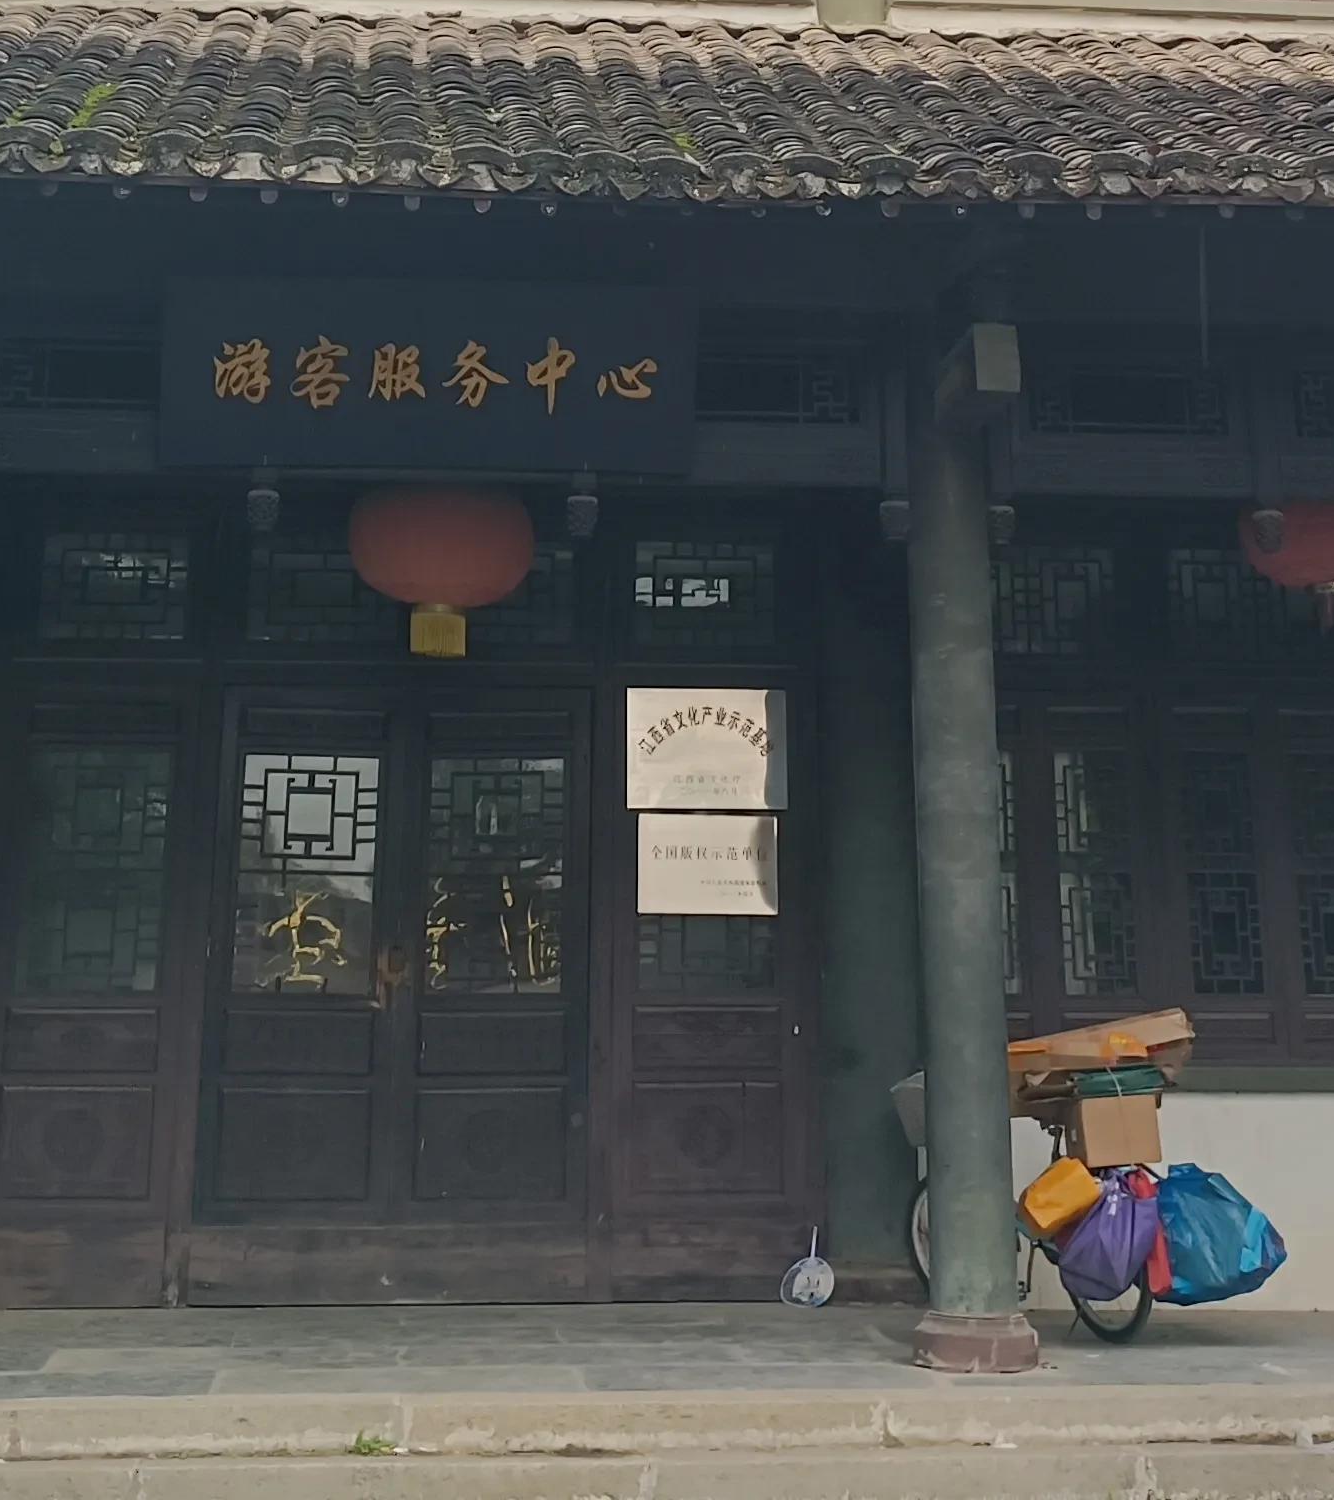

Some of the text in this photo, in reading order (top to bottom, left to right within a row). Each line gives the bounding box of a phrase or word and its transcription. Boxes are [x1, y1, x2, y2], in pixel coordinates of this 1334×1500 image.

[213, 334, 659, 416] 游客服务中心
[637, 705, 775, 757] 江西省文化产业示范基地
